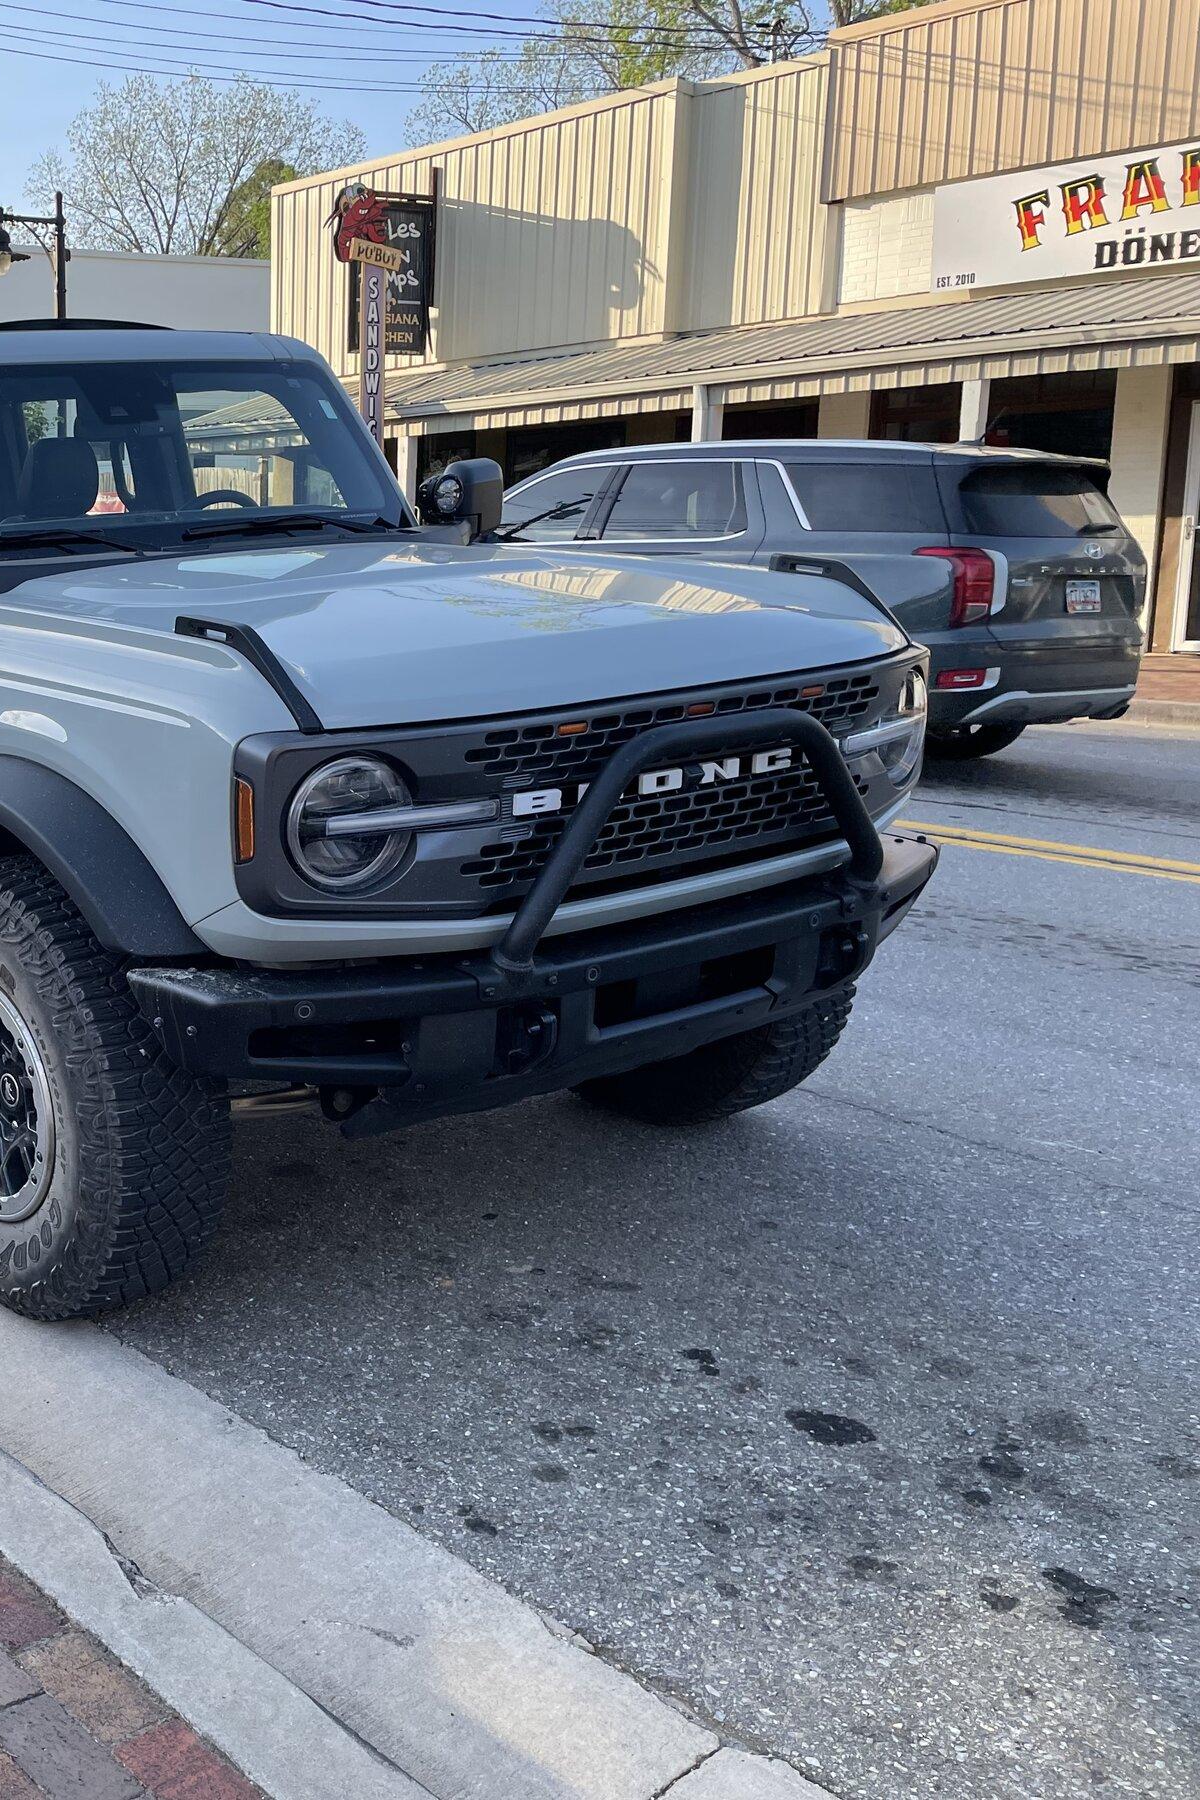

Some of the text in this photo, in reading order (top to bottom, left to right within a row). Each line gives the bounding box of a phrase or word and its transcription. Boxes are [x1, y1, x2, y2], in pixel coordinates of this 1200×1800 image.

[936, 273, 975, 288] EST. 2010
[385, 313, 420, 325] SIANA
[385, 331, 413, 343] CHEN
[513, 738, 839, 816] BONC
